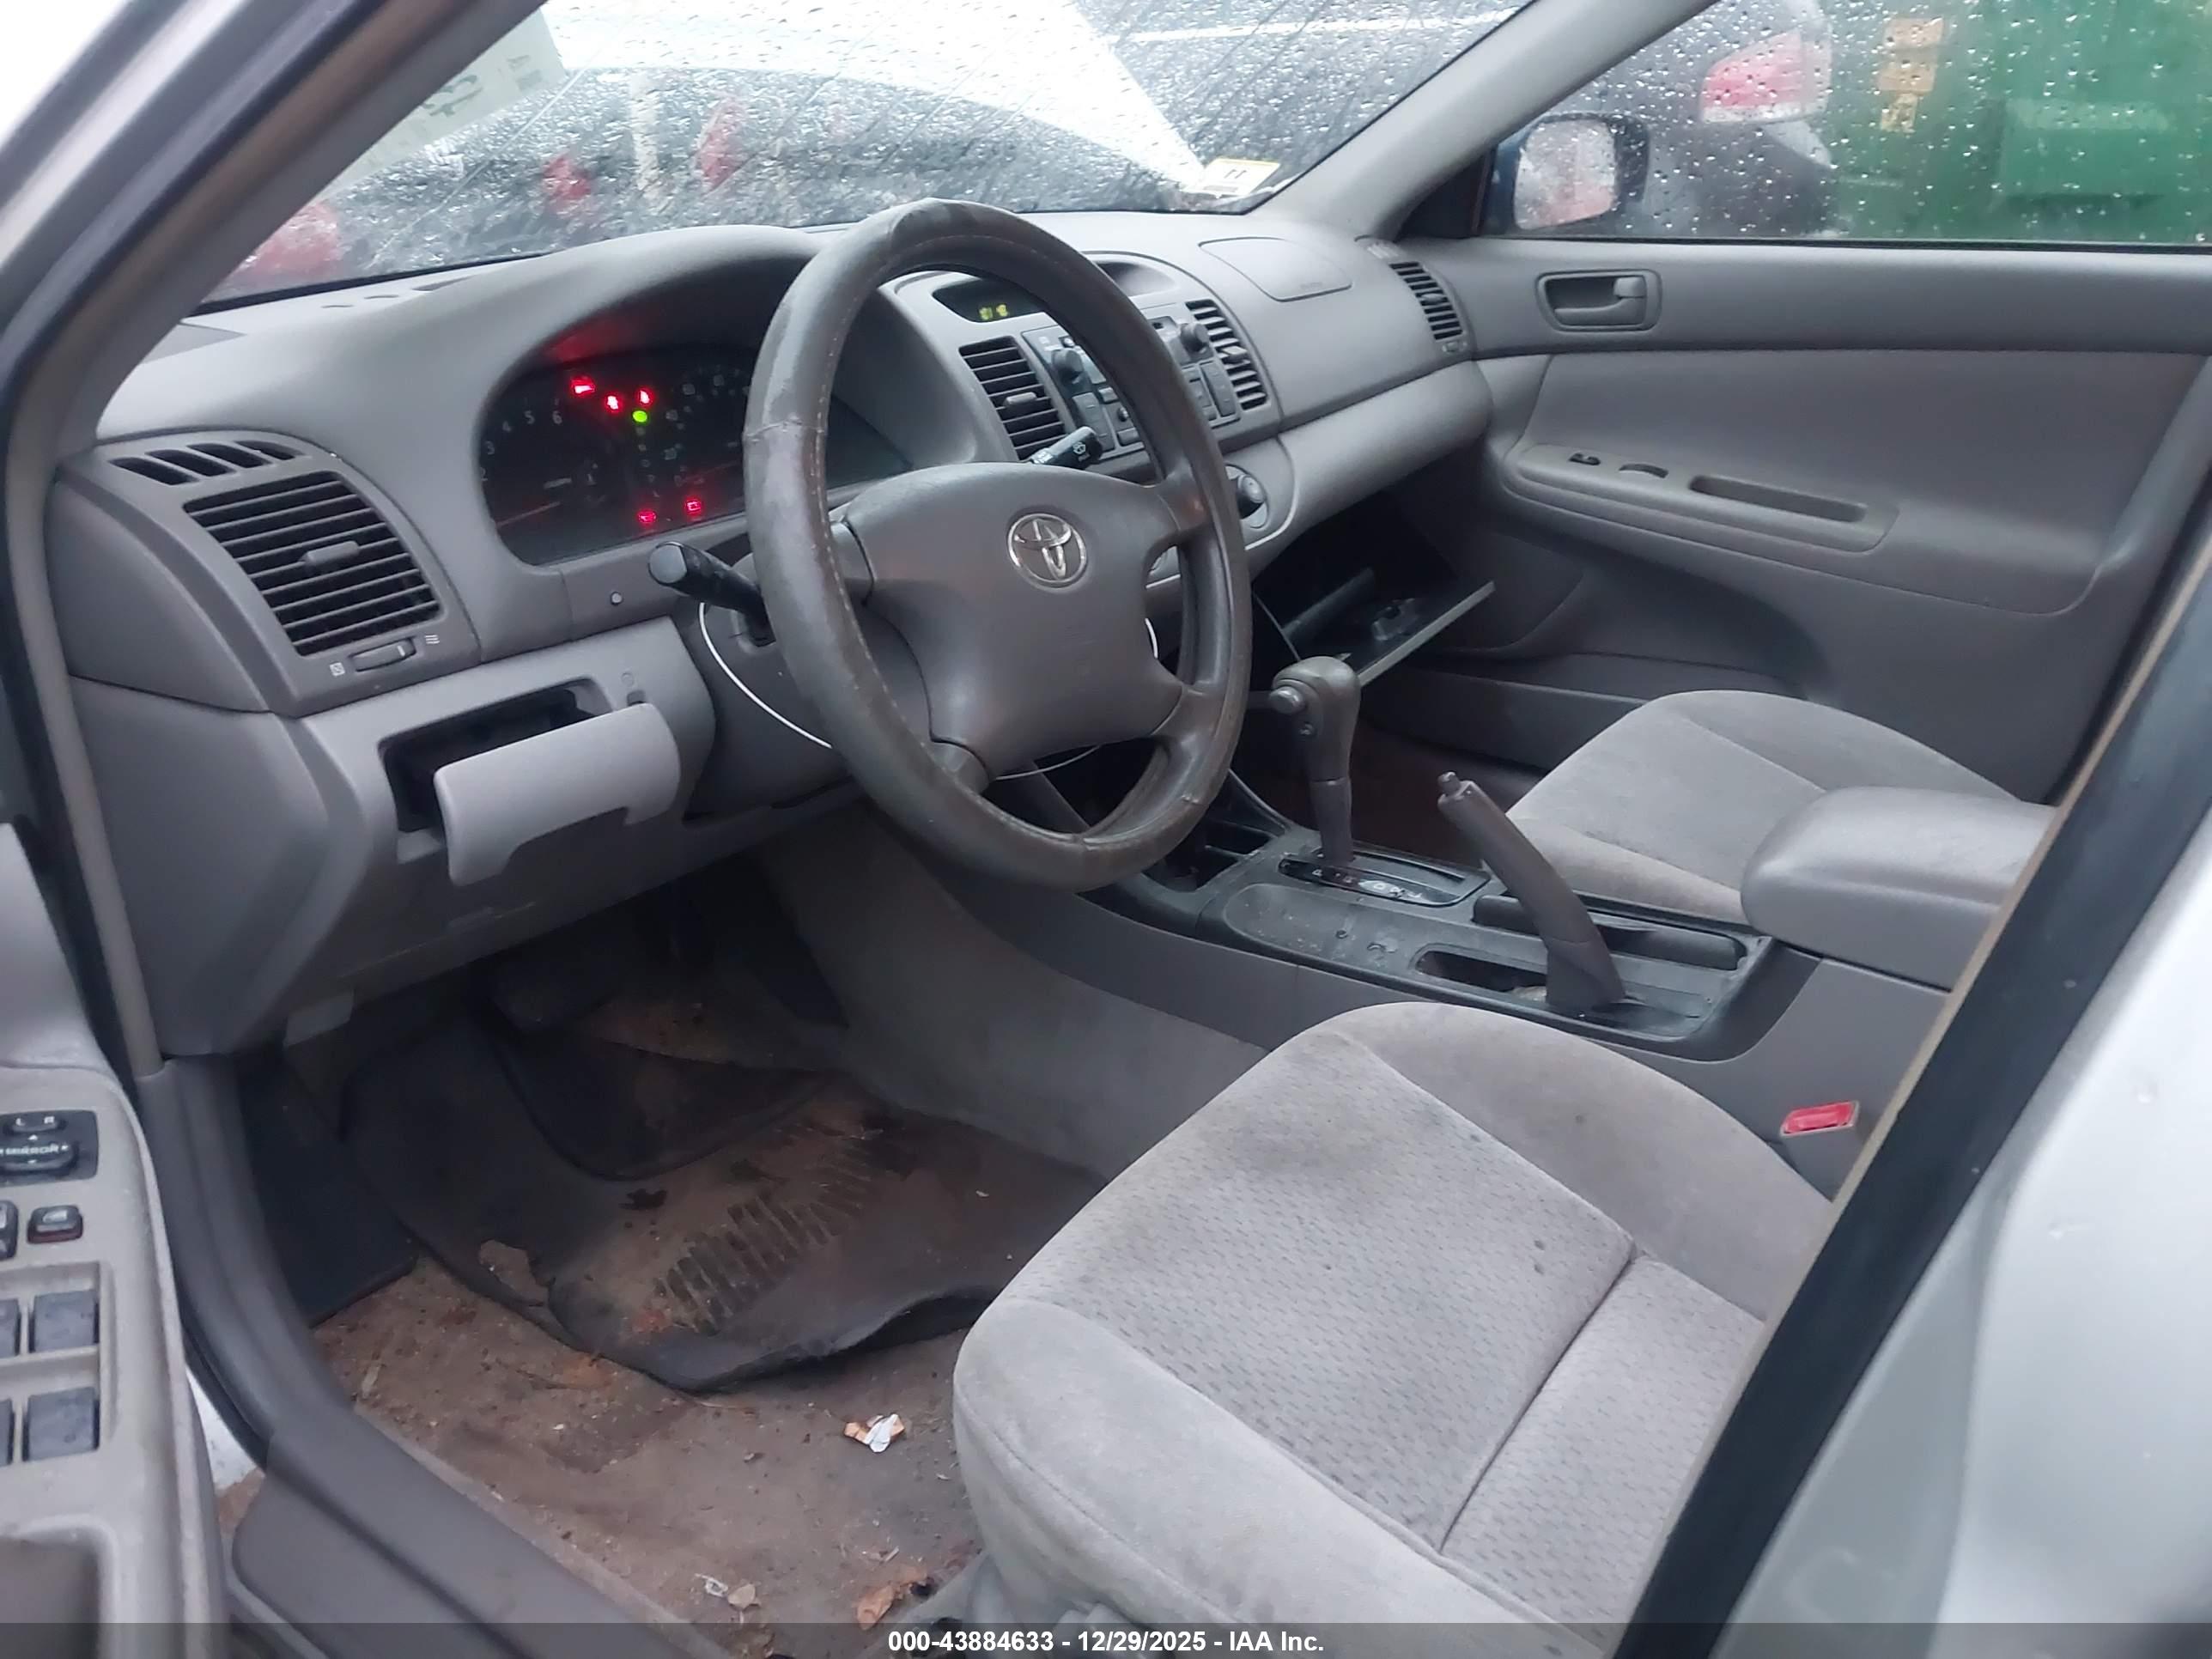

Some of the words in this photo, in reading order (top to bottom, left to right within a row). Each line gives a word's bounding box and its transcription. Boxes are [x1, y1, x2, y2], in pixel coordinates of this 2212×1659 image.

[524, 410, 535, 424] 5
[552, 410, 563, 424] 6
[484, 440, 495, 455] 3
